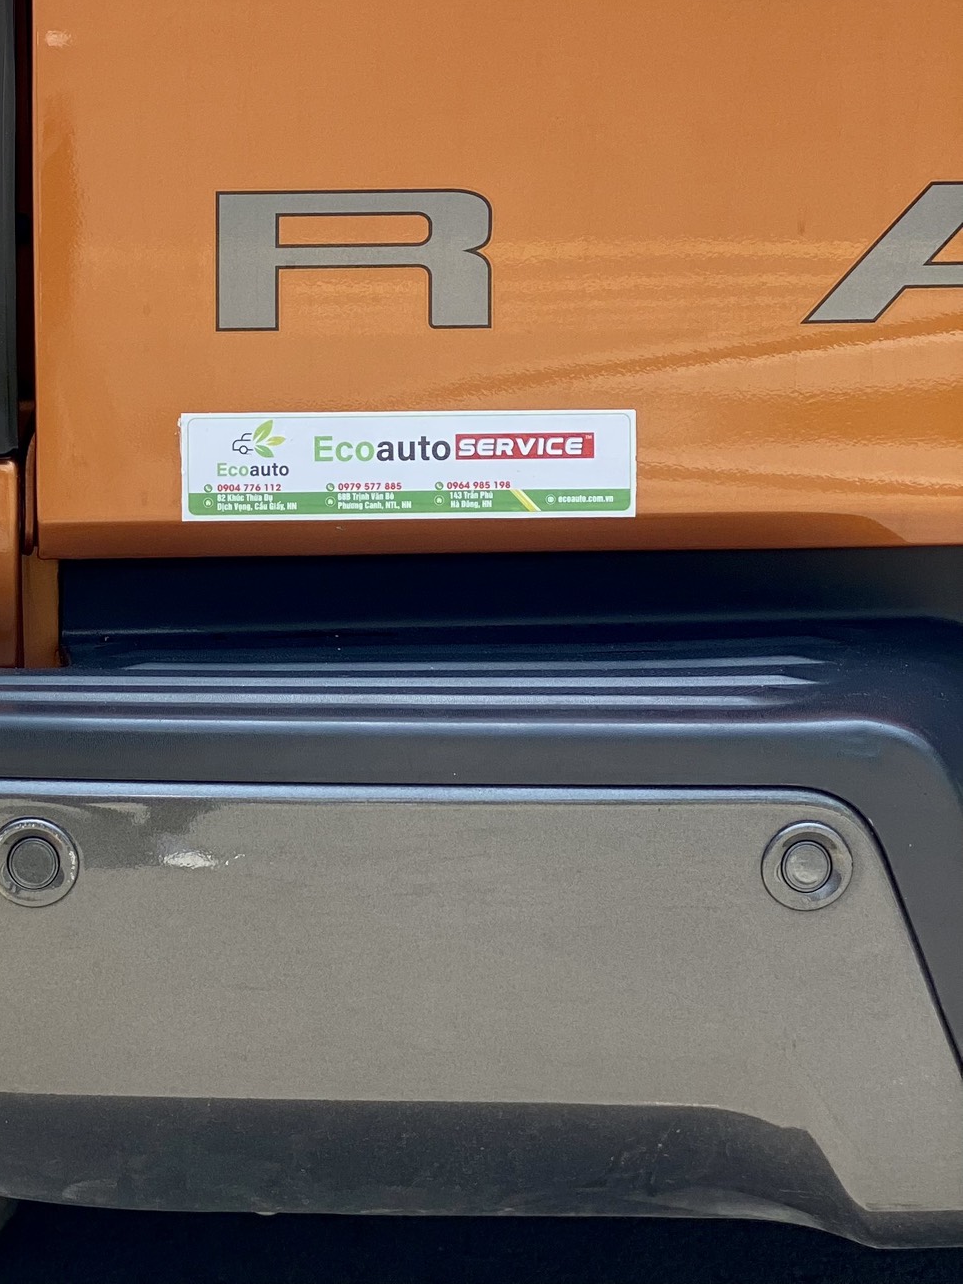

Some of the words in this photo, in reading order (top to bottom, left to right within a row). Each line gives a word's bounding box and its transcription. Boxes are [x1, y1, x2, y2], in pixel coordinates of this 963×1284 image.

[313, 435, 451, 462] Ecoauto
[458, 437, 583, 457] SERVICE
[217, 463, 290, 477] Ecoauto
[217, 484, 241, 492] 0904
[244, 484, 261, 492] 776
[265, 483, 282, 491] 112
[337, 482, 361, 491] 0979
[364, 482, 382, 490] 577
[384, 482, 402, 490] 885
[446, 481, 470, 490] 0964
[472, 481, 491, 489] 985
[494, 481, 511, 489] 198
[449, 491, 462, 500] 143
[557, 494, 614, 503] ecoauto.com.vn
[287, 502, 298, 510] HN
[385, 501, 401, 510] NTL,
[401, 500, 412, 509] HN
[482, 499, 492, 508] HN
